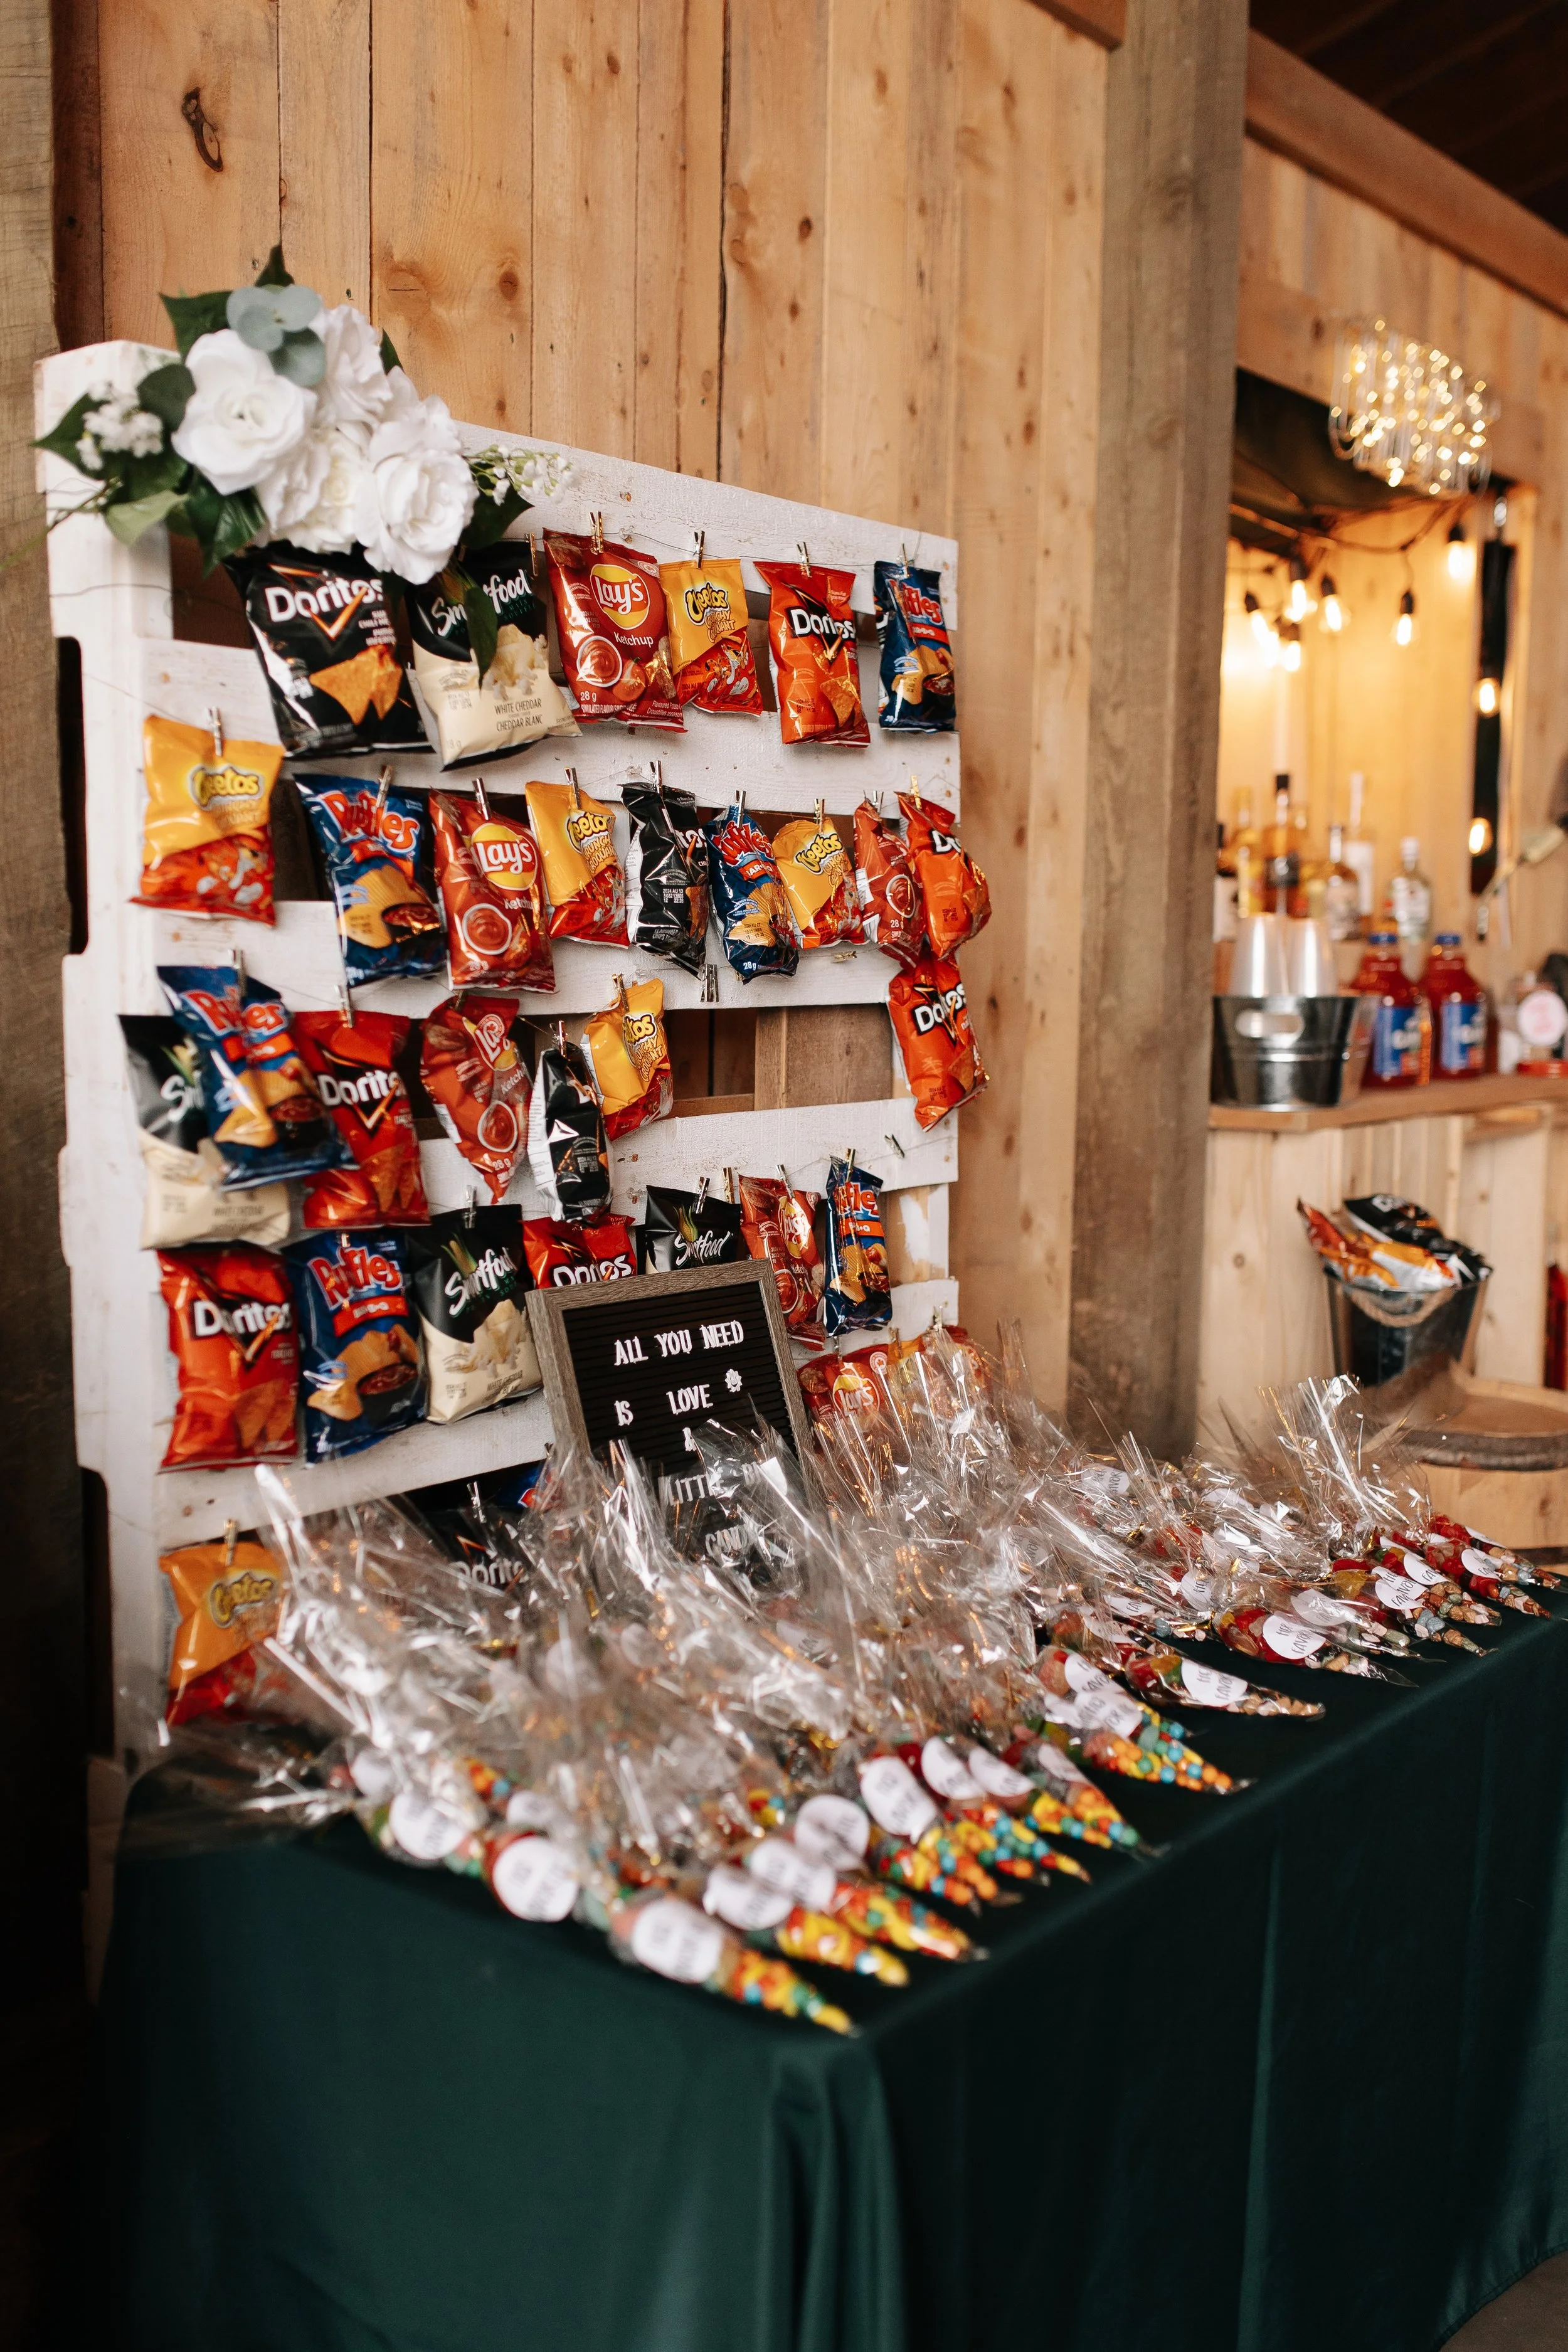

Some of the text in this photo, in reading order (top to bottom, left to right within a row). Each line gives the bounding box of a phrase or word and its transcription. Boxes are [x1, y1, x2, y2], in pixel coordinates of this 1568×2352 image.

[264, 570, 384, 623] Doritos
[594, 576, 644, 615] Lay's
[685, 582, 729, 625] Cheetos
[613, 631, 654, 649] Ketchup
[495, 697, 542, 716] WHITE CHEDDAR
[580, 691, 597, 702] 28 g
[496, 718, 524, 733] CHEDDAR
[476, 839, 532, 874] Lay's
[584, 835, 612, 860] CRUNCH
[588, 846, 617, 874] CROQUAN
[795, 833, 842, 873] Cheetos
[503, 896, 534, 910] Ketchu
[890, 919, 899, 928] 28
[309, 1246, 403, 1310] Ruffles
[837, 1315, 845, 1323] 28
[614, 1320, 744, 1366] ALL YOU NEED
[614, 1384, 714, 1427] IS LOVE
[682, 1427, 697, 1452] &
[704, 1523, 753, 1557] CAND
